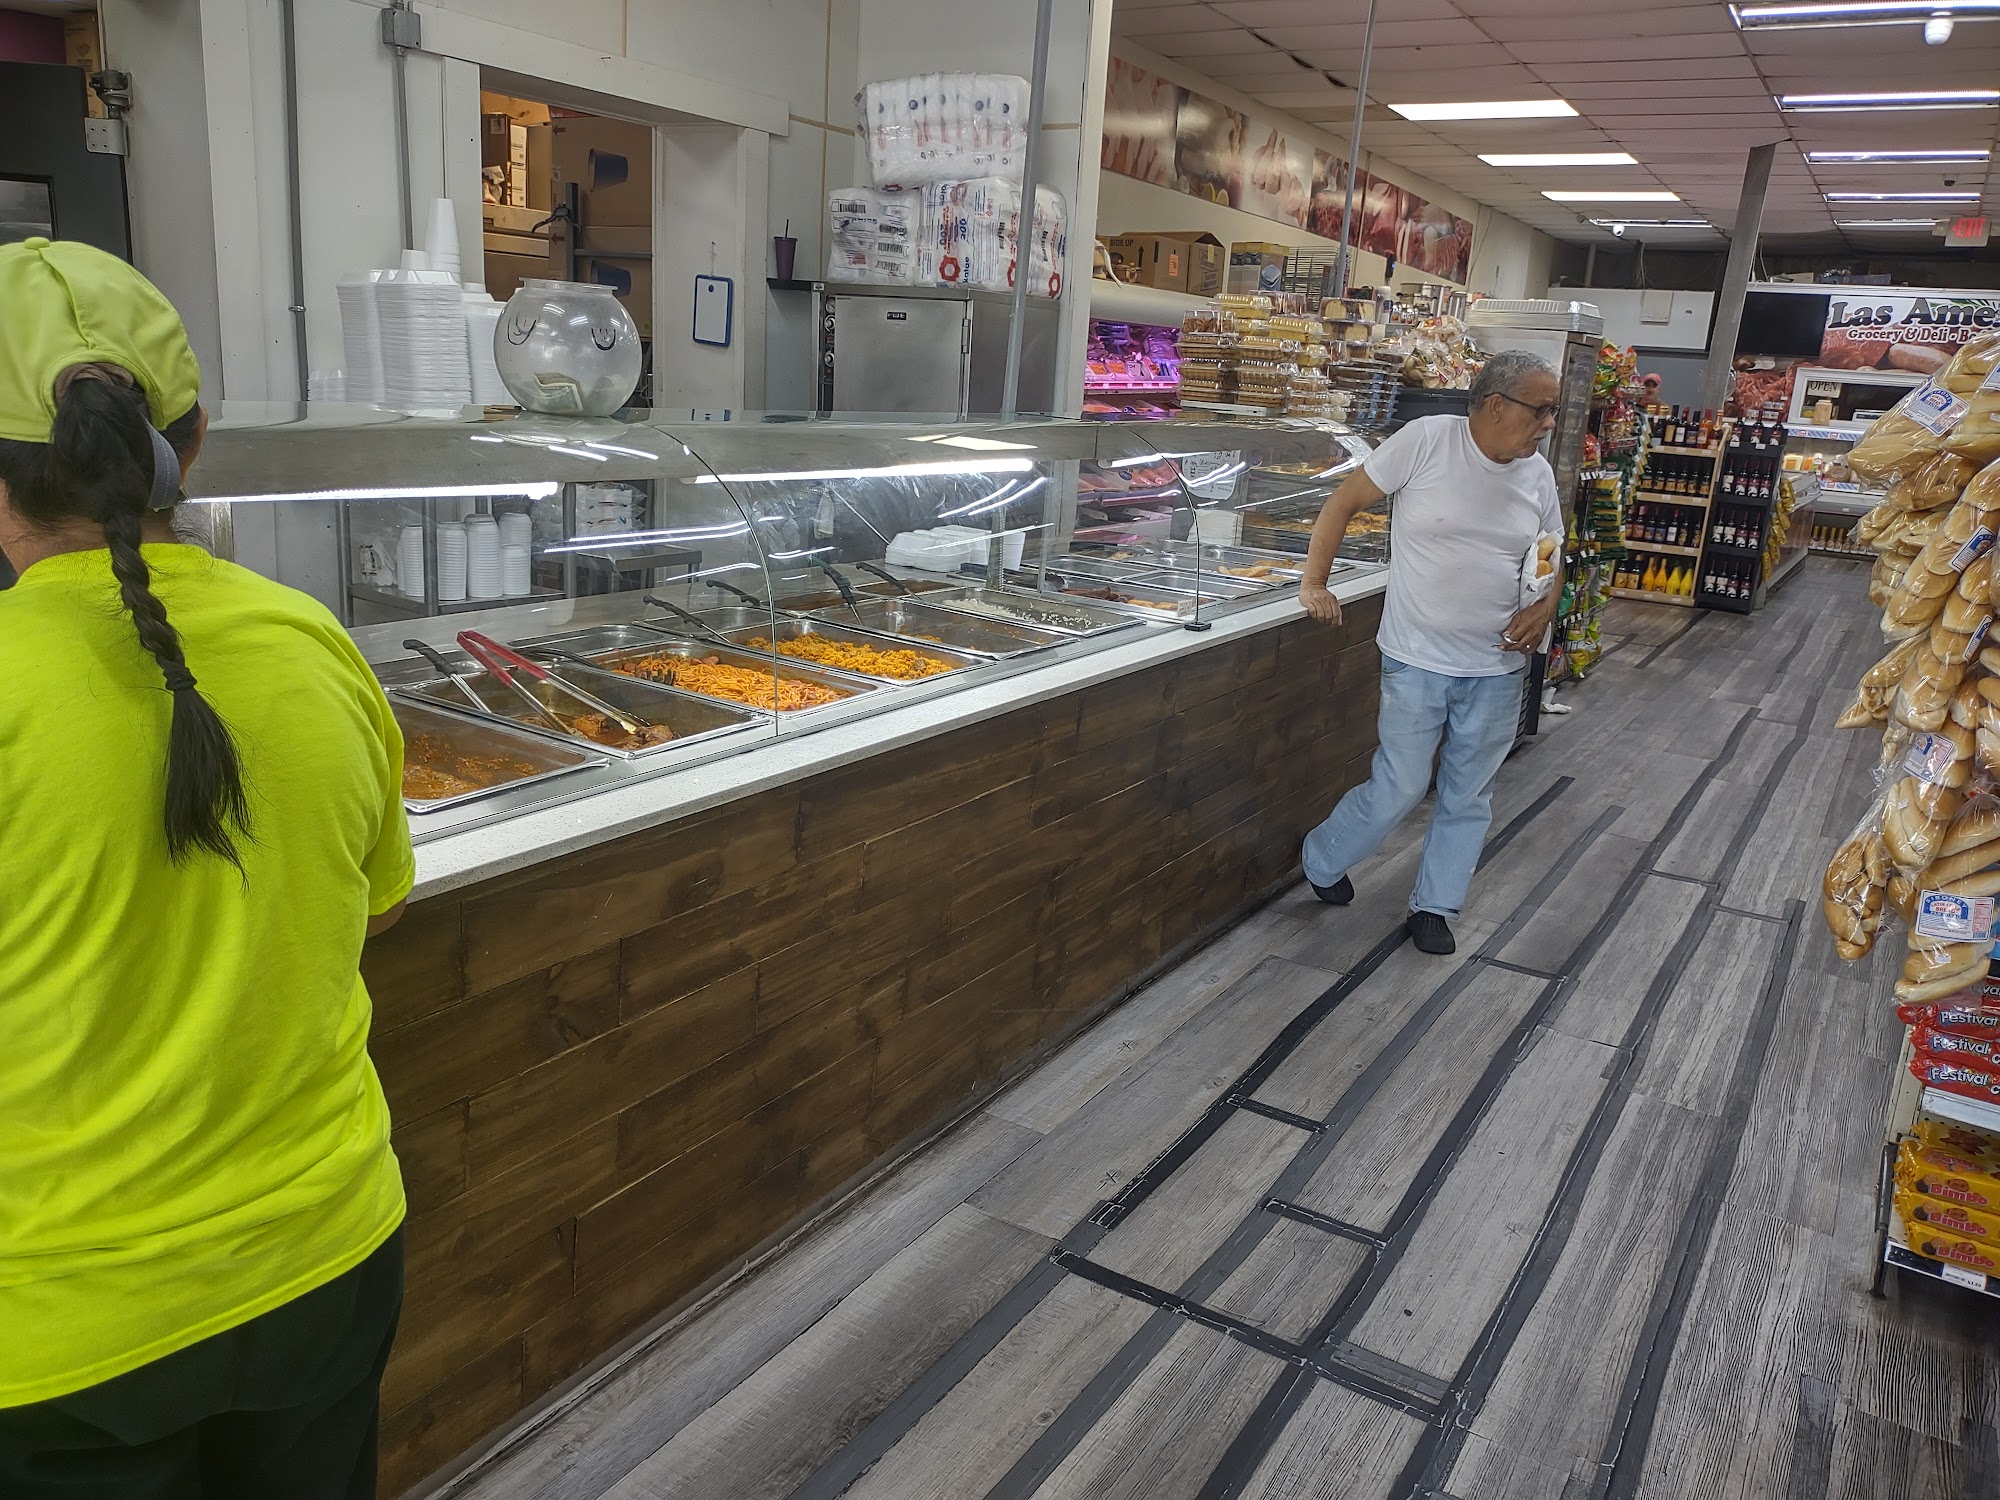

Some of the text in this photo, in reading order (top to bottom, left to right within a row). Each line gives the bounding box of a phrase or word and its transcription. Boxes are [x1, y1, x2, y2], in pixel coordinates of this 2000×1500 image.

[1955, 217, 1985, 238] EXIT
[1110, 239, 1134, 247] SIDE UP
[1828, 301, 1894, 328] Las
[1849, 329, 1902, 342] Grocery
[1905, 328, 1918, 339] &
[1920, 328, 1948, 342] Deli
[1810, 380, 1838, 391] OPEN
[1925, 895, 1968, 908] SIBONEY
[1941, 1010, 1998, 1027] Festival
[1932, 1035, 1990, 1055] Festival
[1931, 1067, 1989, 1086] Festival
[1930, 1183, 1988, 1206] Bimbo
[1929, 1211, 1987, 1235] Bimbo
[1937, 1246, 1996, 1268] Bimbo
